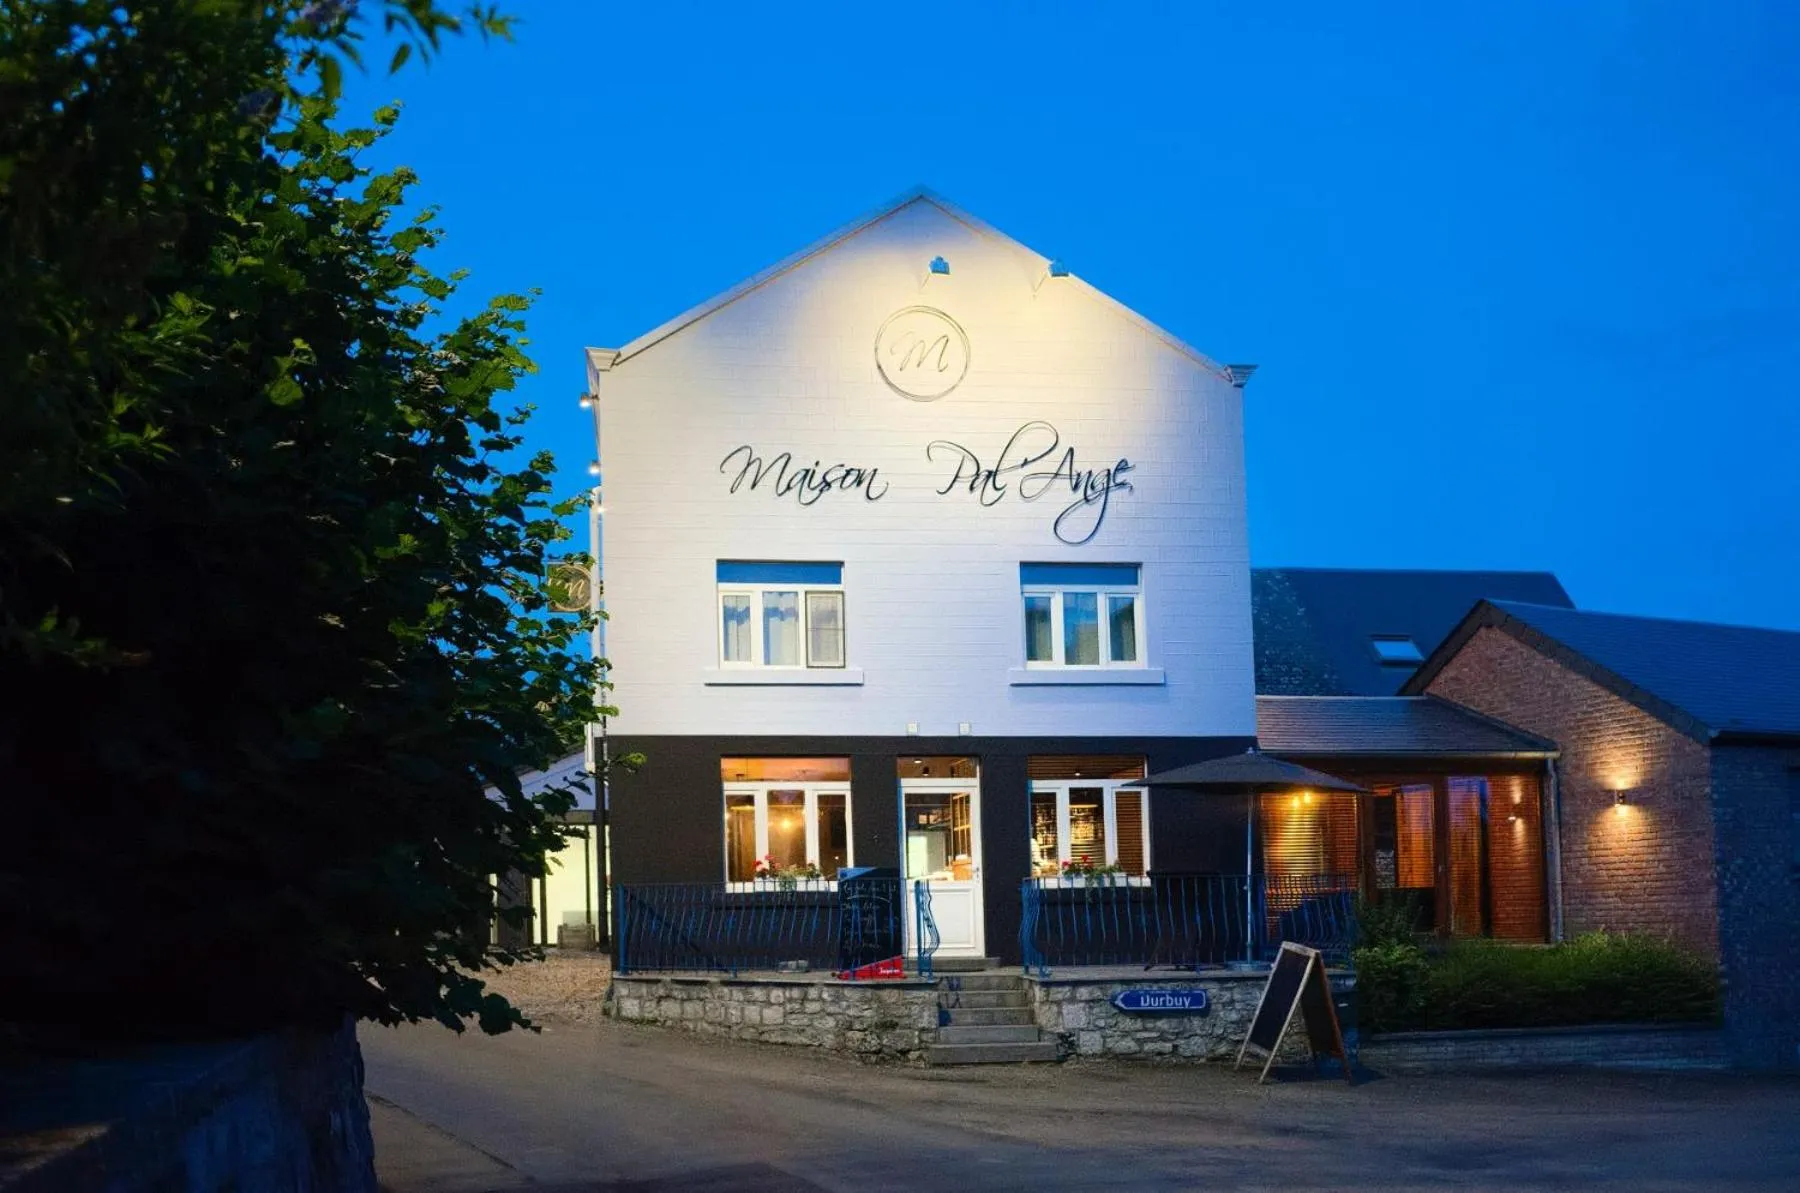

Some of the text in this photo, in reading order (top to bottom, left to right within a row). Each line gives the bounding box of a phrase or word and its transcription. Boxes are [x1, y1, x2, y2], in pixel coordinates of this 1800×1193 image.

[890, 333, 950, 373] M
[720, 445, 888, 506] Maison
[1140, 995, 1191, 1008] Durbuy
